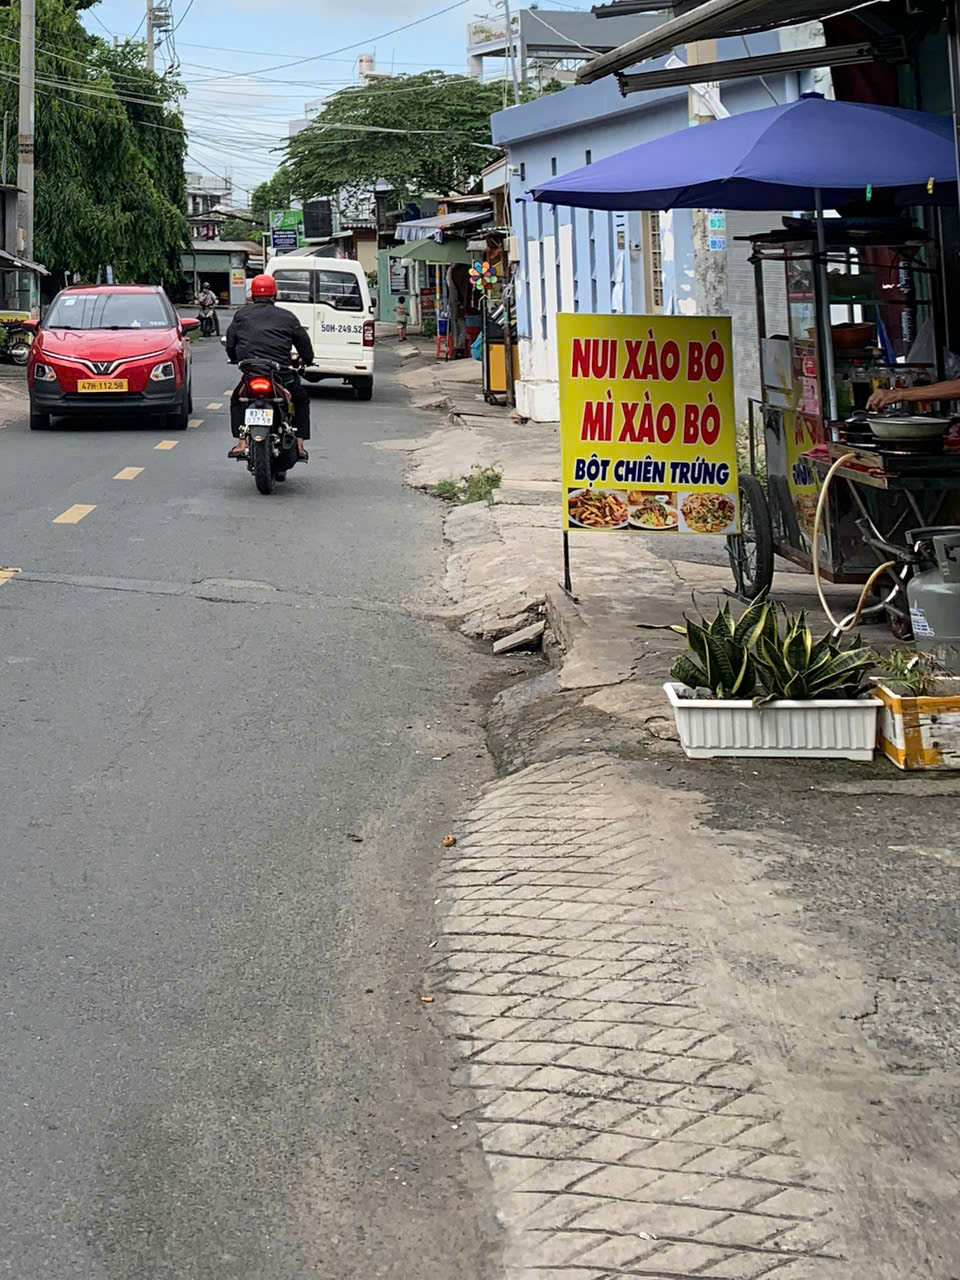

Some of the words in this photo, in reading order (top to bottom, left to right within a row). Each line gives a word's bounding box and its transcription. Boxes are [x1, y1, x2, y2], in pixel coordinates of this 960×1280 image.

[321, 323, 363, 334] 50H-249.52
[571, 338, 618, 379] NUI
[623, 328, 680, 382] XÀO
[687, 329, 725, 383] BÒ
[580, 388, 614, 442] MÌ
[618, 391, 676, 444] XÀO
[683, 392, 721, 445] BÒ
[574, 453, 610, 487] BỘT
[614, 455, 665, 484] CHIÊN
[669, 456, 730, 486] TRỨNG
